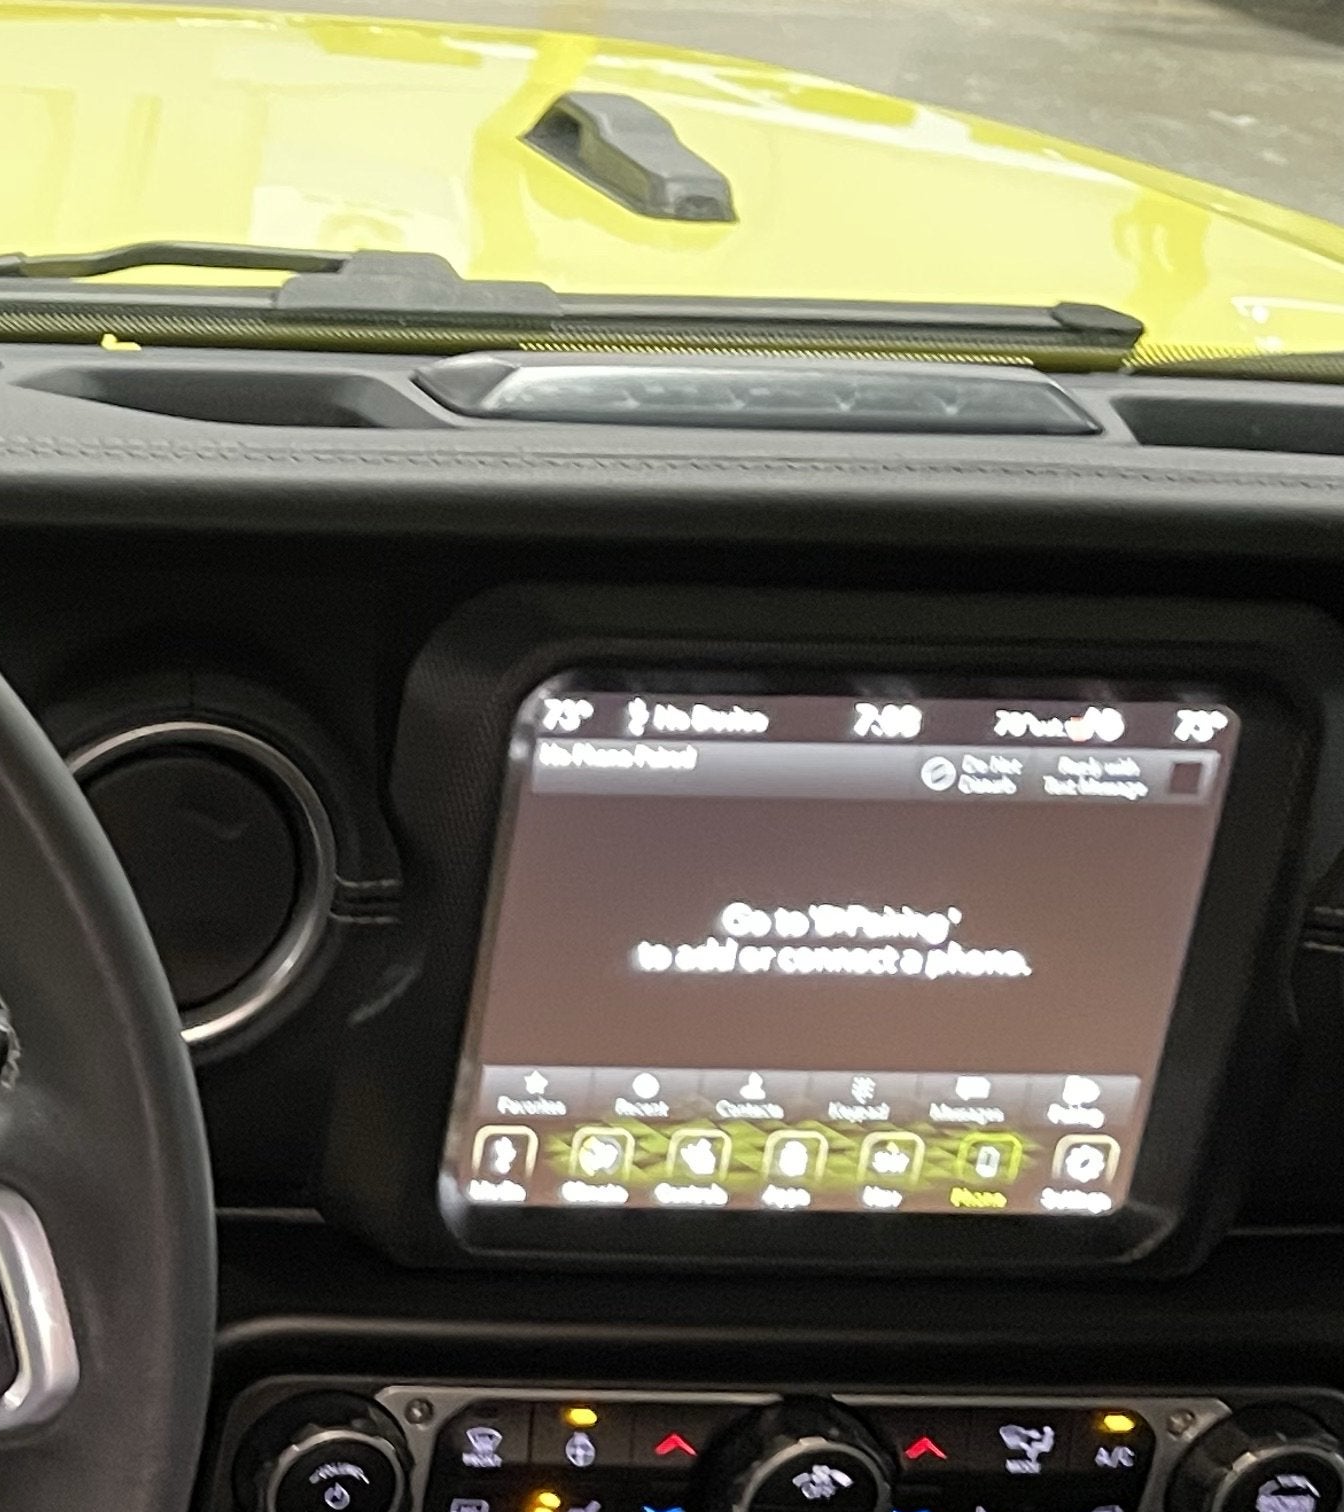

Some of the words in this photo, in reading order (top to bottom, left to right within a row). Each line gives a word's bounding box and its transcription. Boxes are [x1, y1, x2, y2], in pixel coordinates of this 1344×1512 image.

[721, 902, 771, 938] Go
[775, 907, 810, 938] to
[638, 941, 673, 973] to
[674, 936, 738, 973] add
[738, 945, 776, 973] or
[777, 944, 900, 975] connect
[900, 948, 924, 975] a
[925, 941, 1032, 980] phone.
